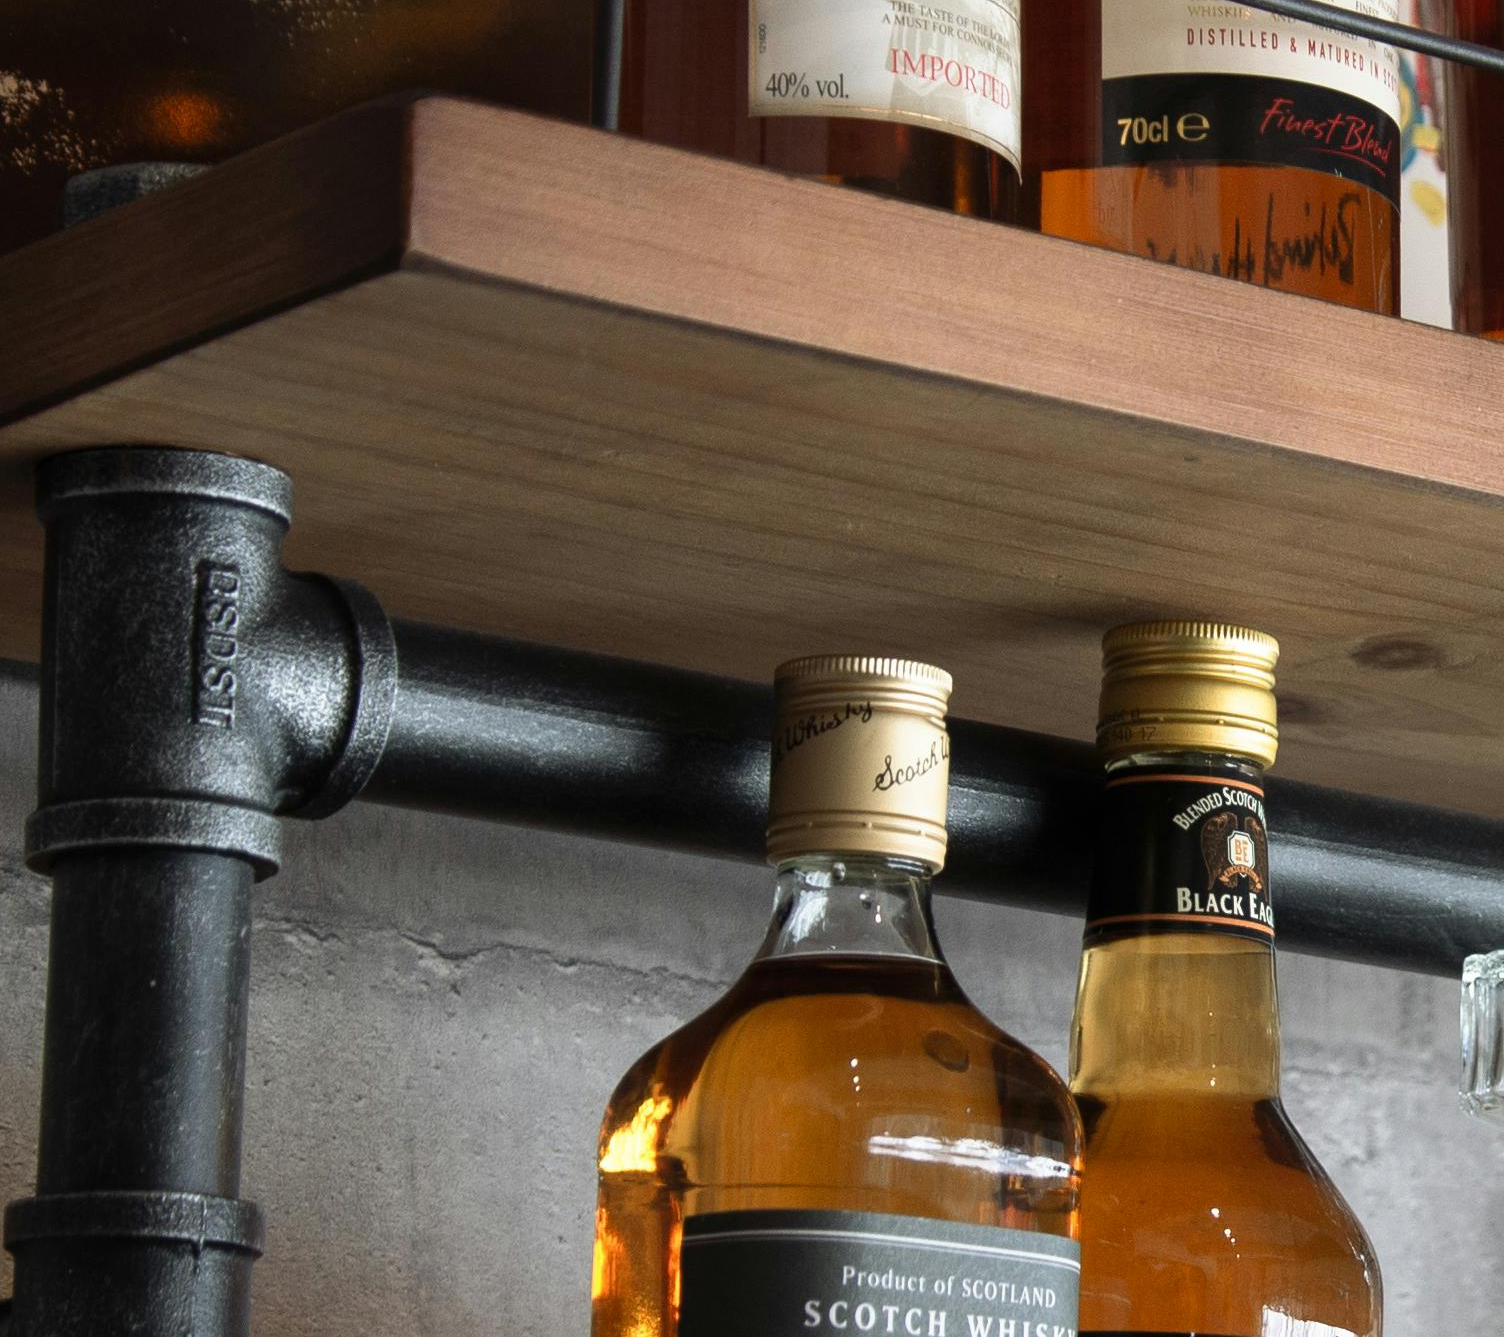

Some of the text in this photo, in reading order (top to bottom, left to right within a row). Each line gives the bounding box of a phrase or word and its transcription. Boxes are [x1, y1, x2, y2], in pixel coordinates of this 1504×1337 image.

[882, 14, 954, 37] A MUST FOR
[890, 0, 915, 14] THE
[919, 4, 954, 24] TASTE
[956, 14, 969, 28] OF
[1187, 28, 1380, 80] DISTILLED & MATURED IN
[765, 71, 850, 99] 40% vol.
[888, 47, 1011, 111] IMPORTED
[1117, 114, 1169, 146] 70cl
[1341, 113, 1394, 164] Blend
[784, 701, 873, 753] Whisky
[872, 740, 938, 792] Scotch
[1172, 791, 1223, 831] BLENDED
[1222, 786, 1258, 812] SCOTCH
[1176, 887, 1244, 917] BLACK
[842, 1265, 1057, 1310] Product of SCOTLAND
